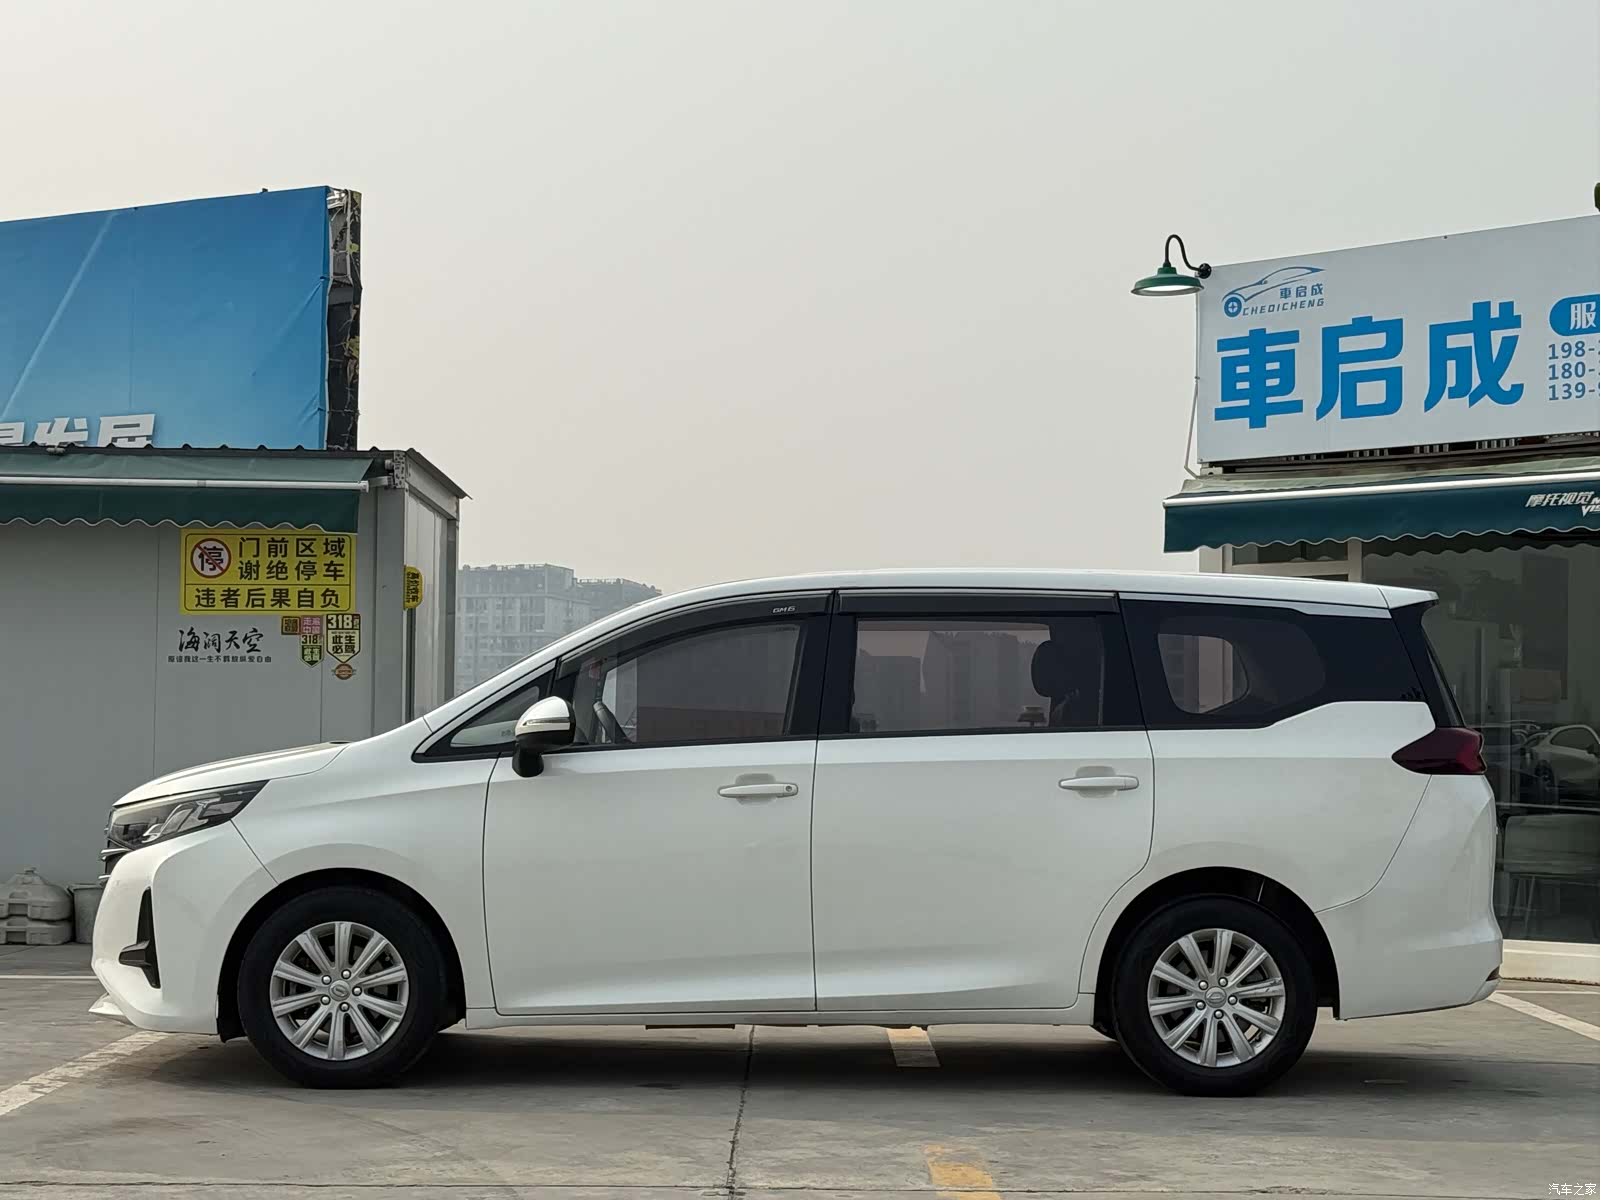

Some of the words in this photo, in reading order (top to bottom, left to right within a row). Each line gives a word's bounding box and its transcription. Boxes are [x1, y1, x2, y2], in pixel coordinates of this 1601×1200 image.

[1279, 283, 1324, 299] 車启成
[1569, 301, 1597, 330] 服
[1548, 340, 1600, 360] 198-
[1214, 300, 1525, 429] 車启成
[1548, 360, 1600, 380] 180-
[1548, 380, 1600, 400] 139-
[1525, 491, 1595, 507] 摩托视觉
[238, 537, 345, 558] 门前区域
[198, 545, 224, 572] 停
[238, 560, 345, 581] 谢绝停车
[194, 587, 341, 609] 违者后果自负
[327, 614, 353, 629] 318
[301, 634, 318, 645] 318
